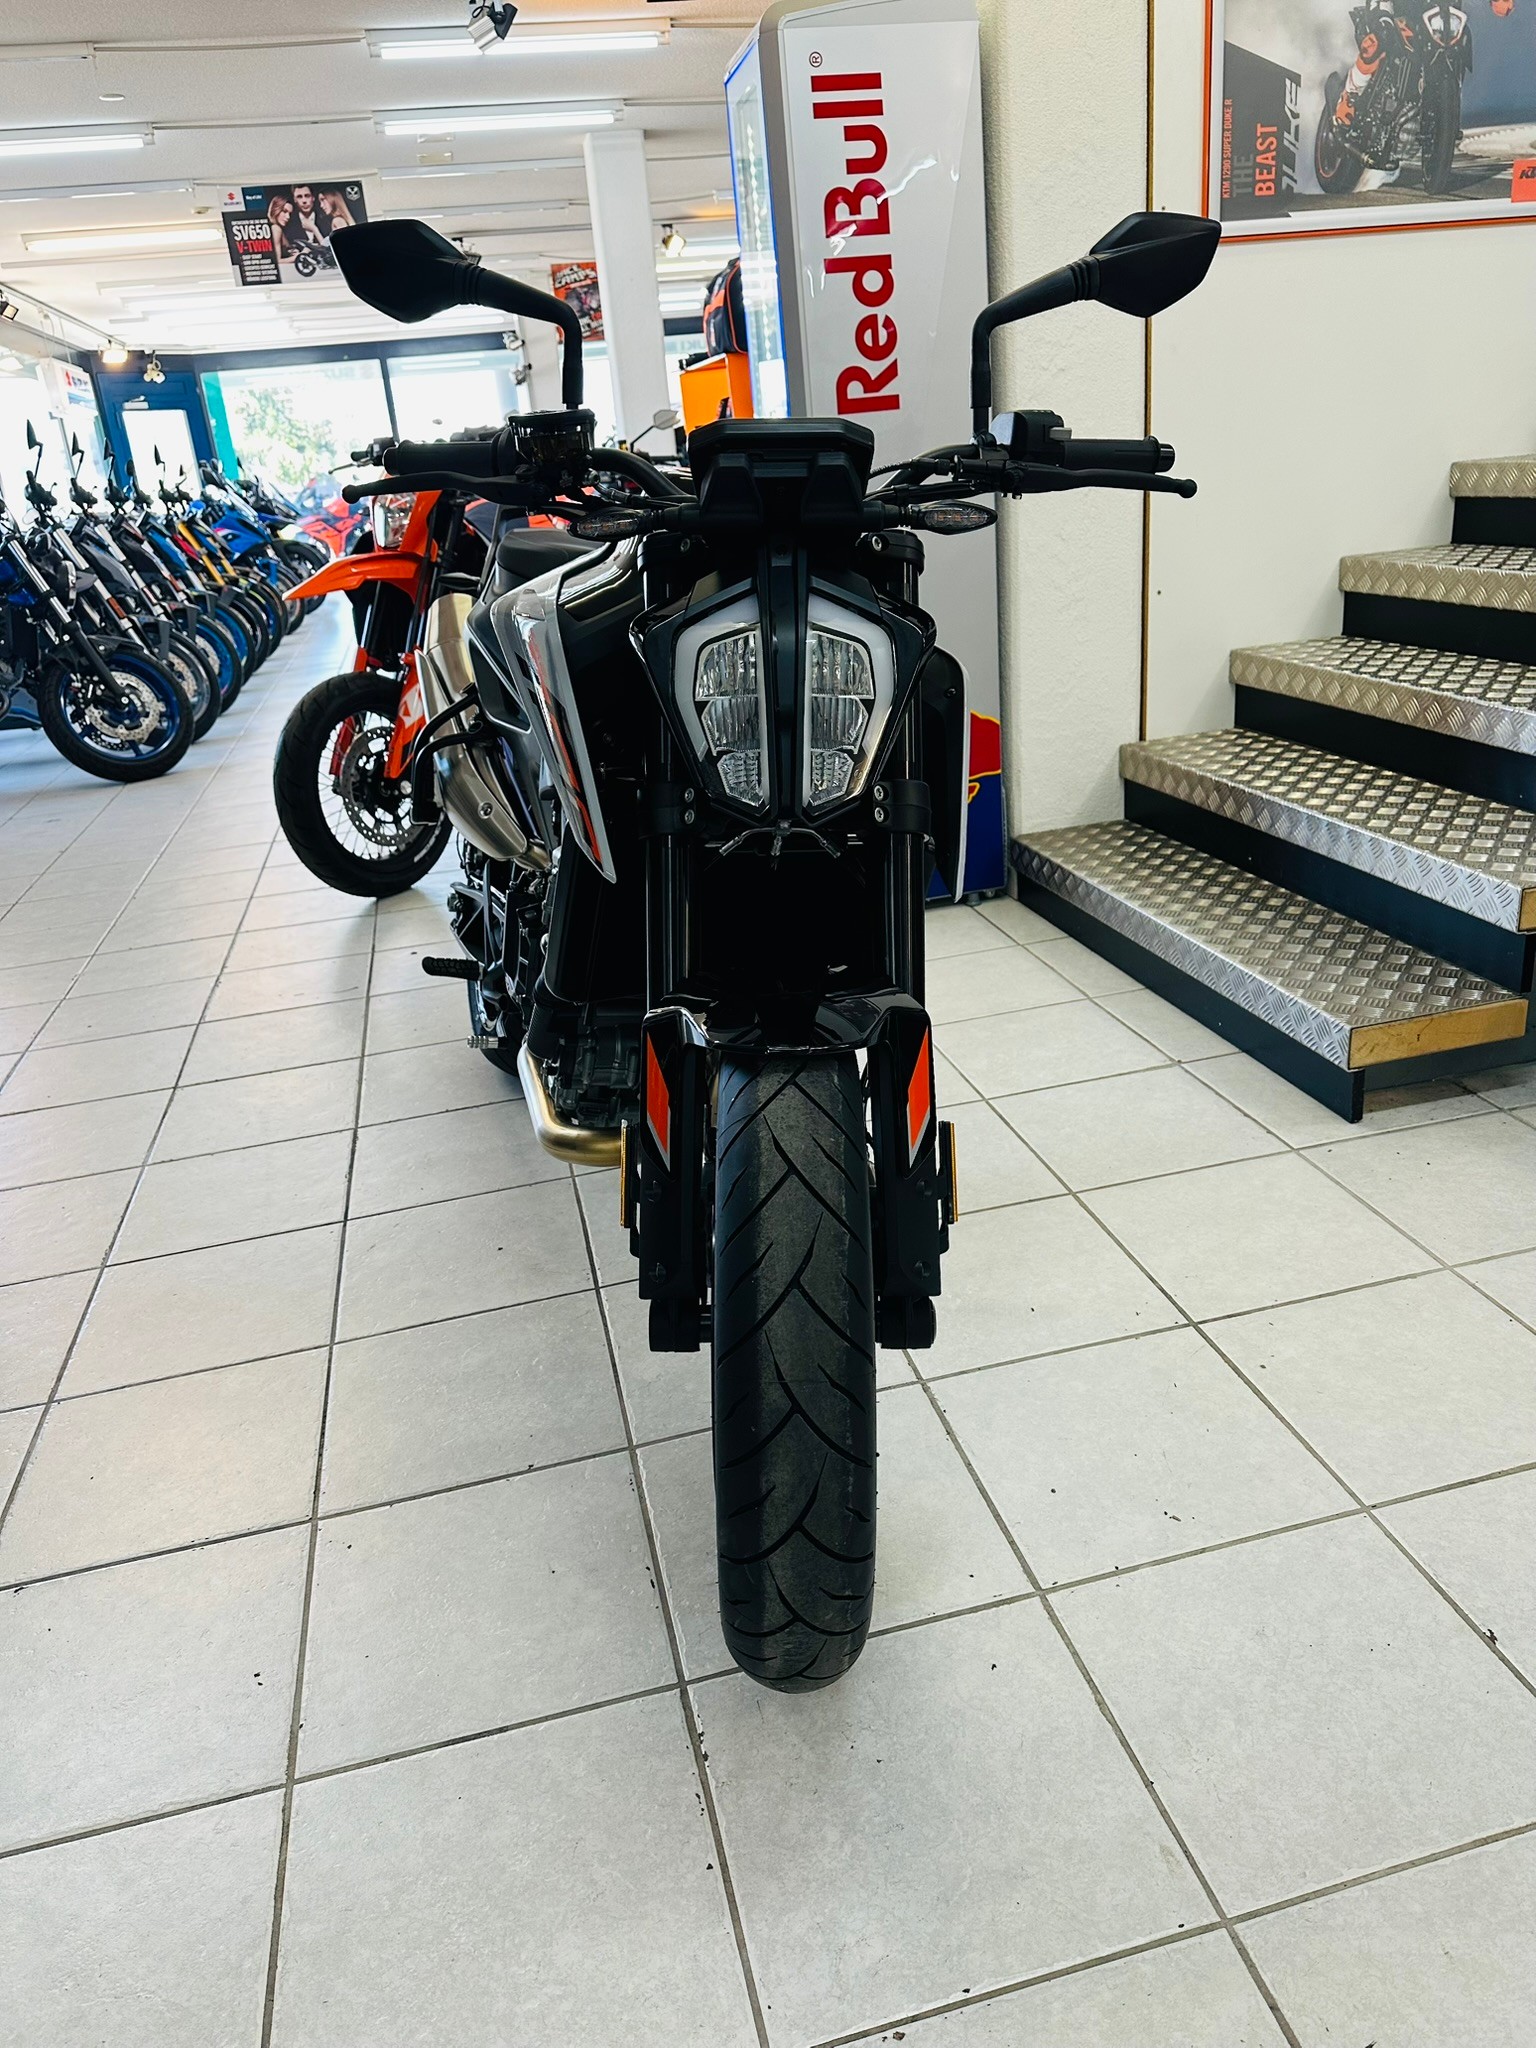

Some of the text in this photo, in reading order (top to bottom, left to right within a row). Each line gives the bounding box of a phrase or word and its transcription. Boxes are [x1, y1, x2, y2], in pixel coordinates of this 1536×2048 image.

[811, 72, 891, 238] Bull
[1222, 98, 1233, 199] KTM 1290 SUPER DUKE R
[1232, 153, 1254, 198] THE
[1254, 123, 1278, 197] BEAST
[232, 224, 271, 241] SV650
[236, 239, 273, 253] V-TWIN
[824, 254, 901, 415] Red
